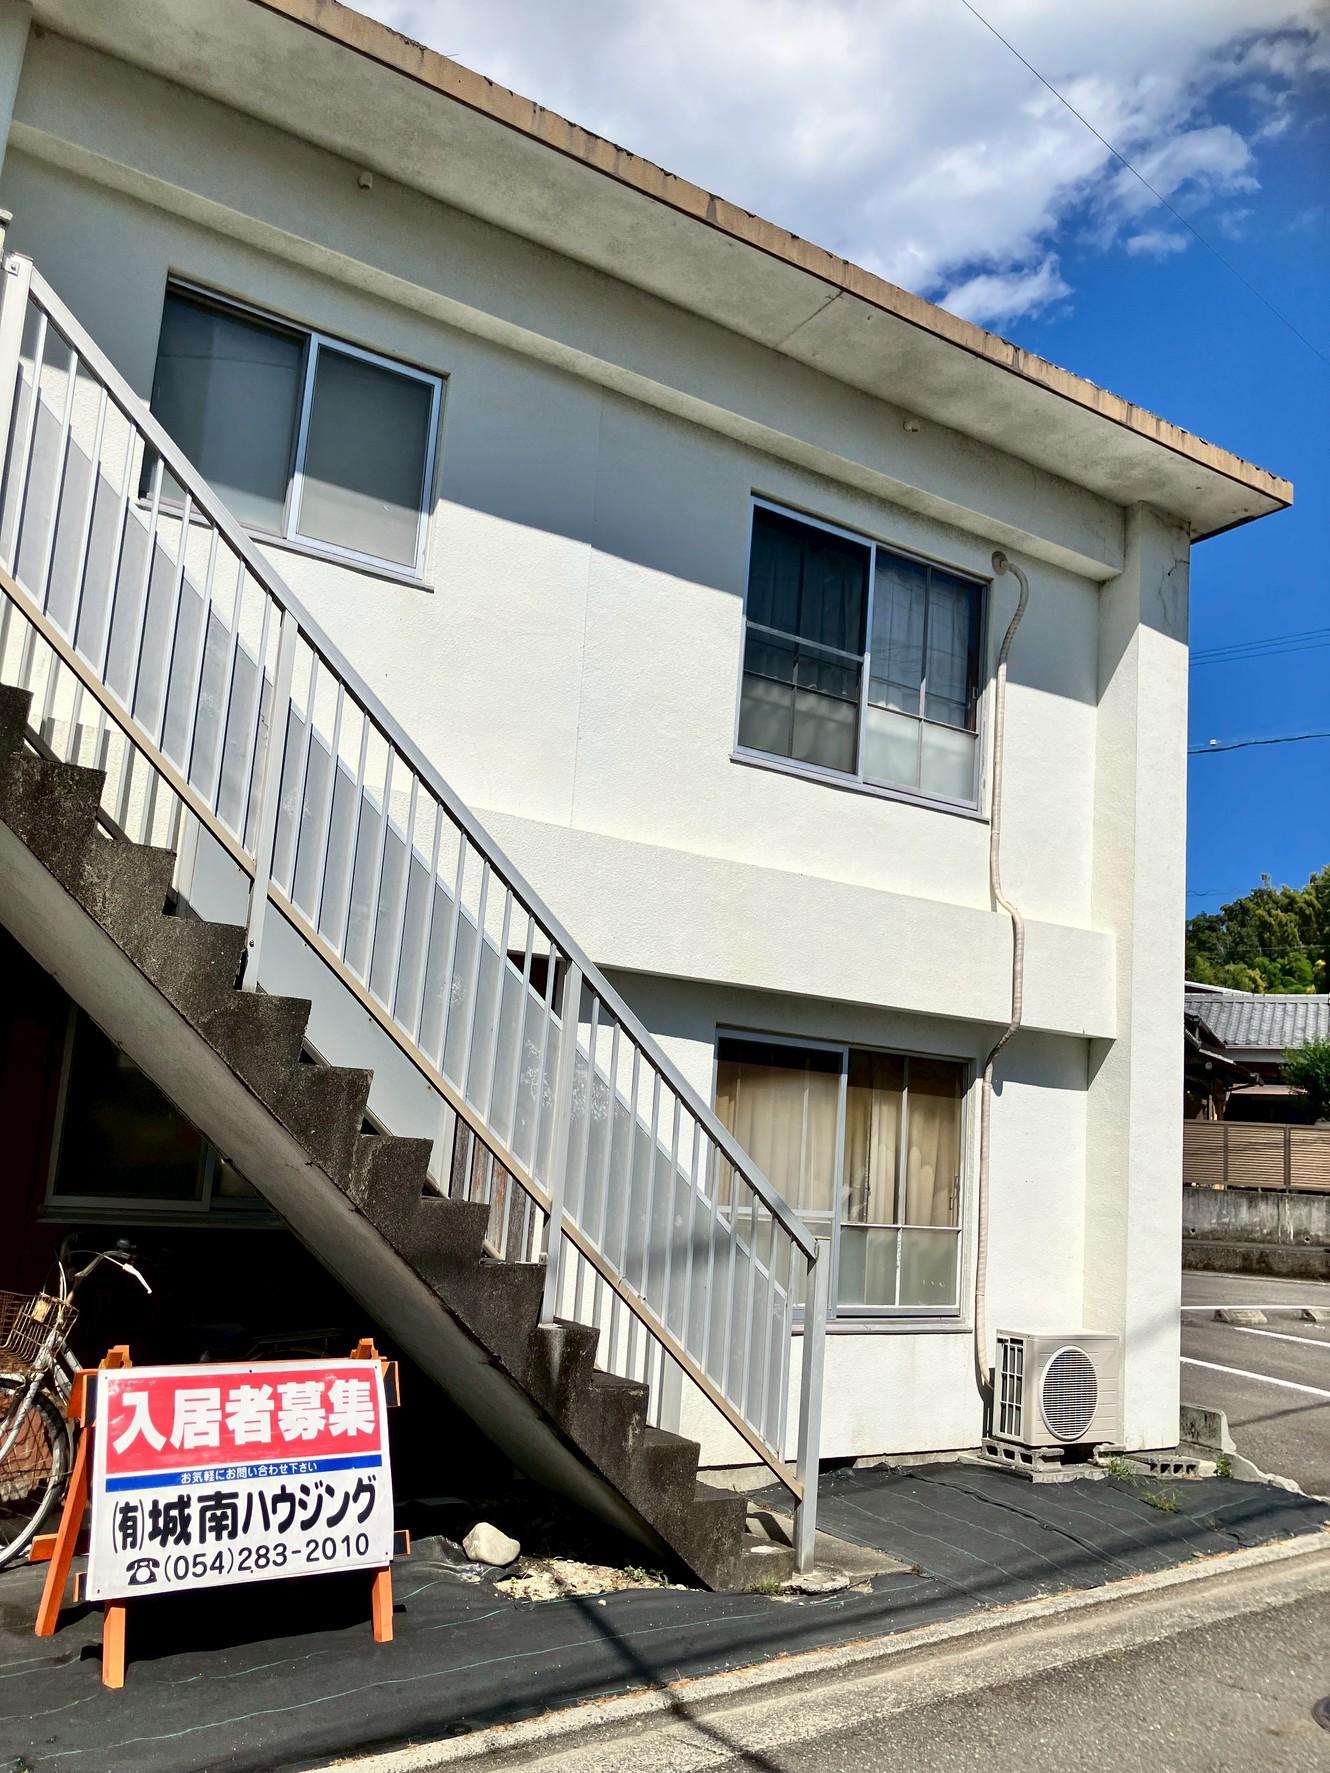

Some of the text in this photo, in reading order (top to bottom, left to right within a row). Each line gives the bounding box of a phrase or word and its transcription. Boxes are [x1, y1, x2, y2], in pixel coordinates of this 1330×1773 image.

[112, 1379, 375, 1454] 入居者募集
[180, 1461, 318, 1484] お気軽にお問い合わせ下さい
[163, 1533, 370, 1583] (054)283-2010
